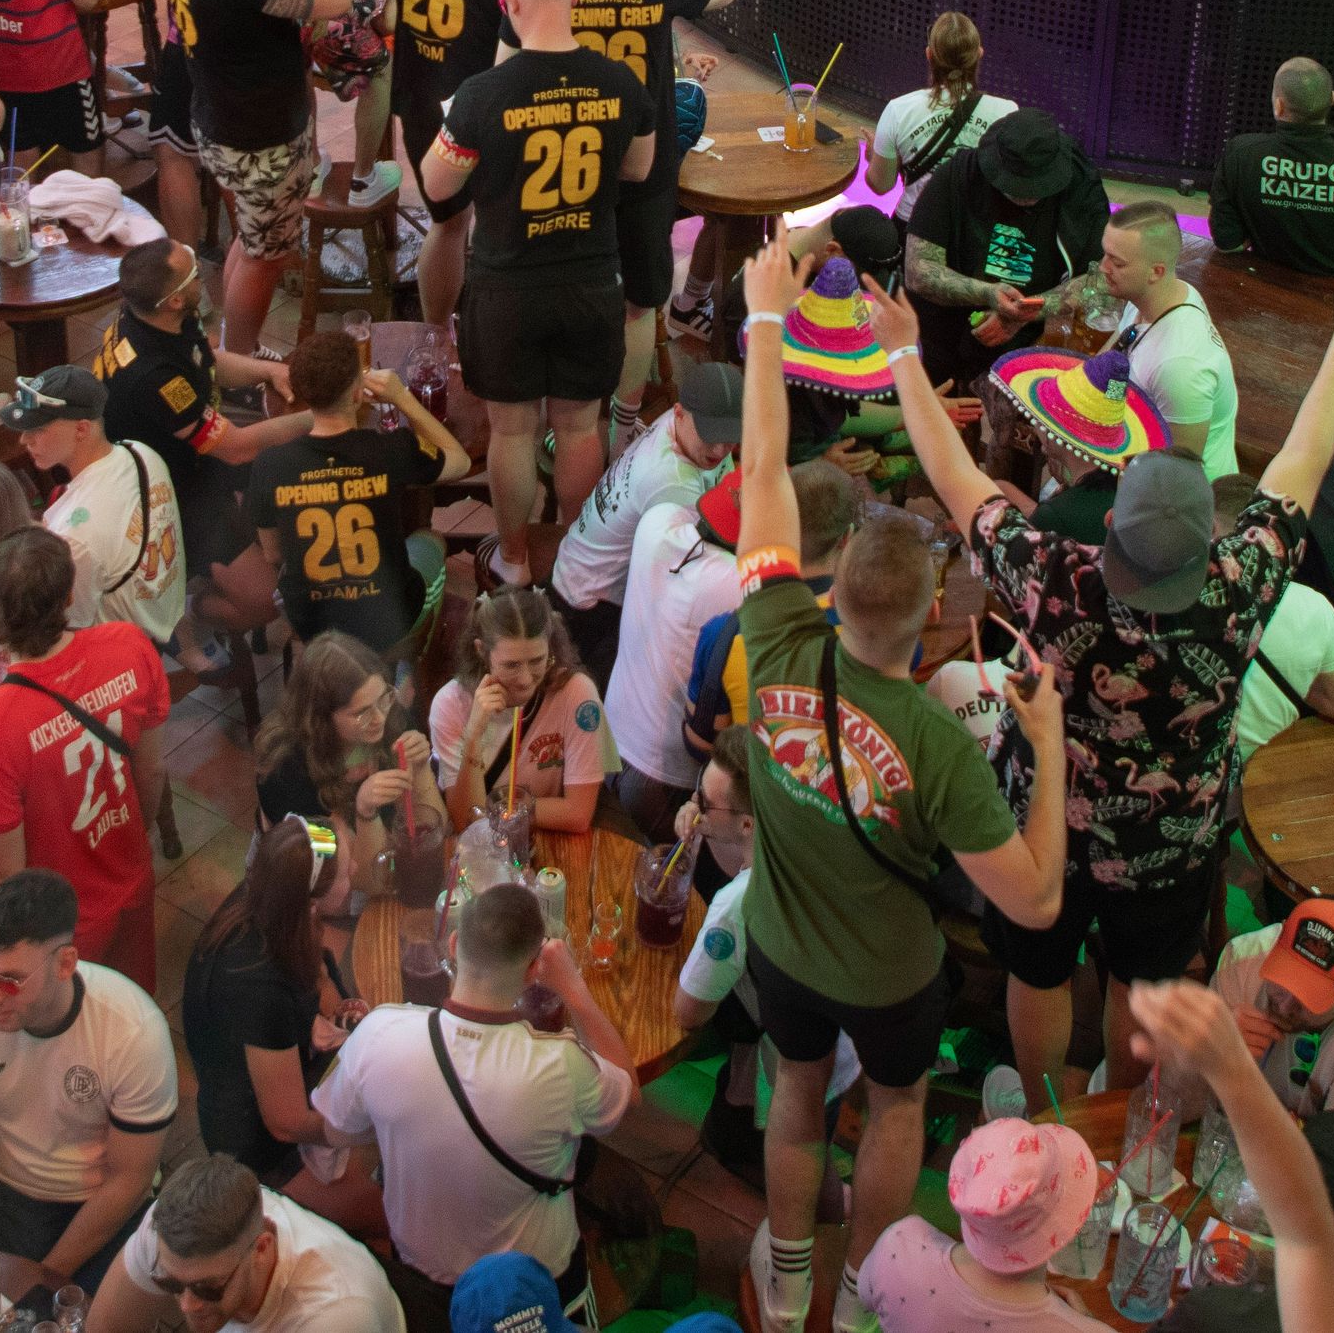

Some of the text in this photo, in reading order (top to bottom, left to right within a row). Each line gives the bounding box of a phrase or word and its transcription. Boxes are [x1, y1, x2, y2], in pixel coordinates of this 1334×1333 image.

[571, 3, 664, 28] ENING CREW
[415, 40, 445, 62] TOM
[533, 87, 599, 103] PROSTHETICS
[503, 97, 621, 131] OPENING CREW
[521, 126, 603, 211] 26
[527, 212, 591, 239] PIERRE
[300, 466, 365, 482] PROSTHETICS
[275, 474, 389, 508] OPENING CREW
[296, 503, 382, 583] 26
[30, 668, 138, 754] KICKERS NEUHOFEN
